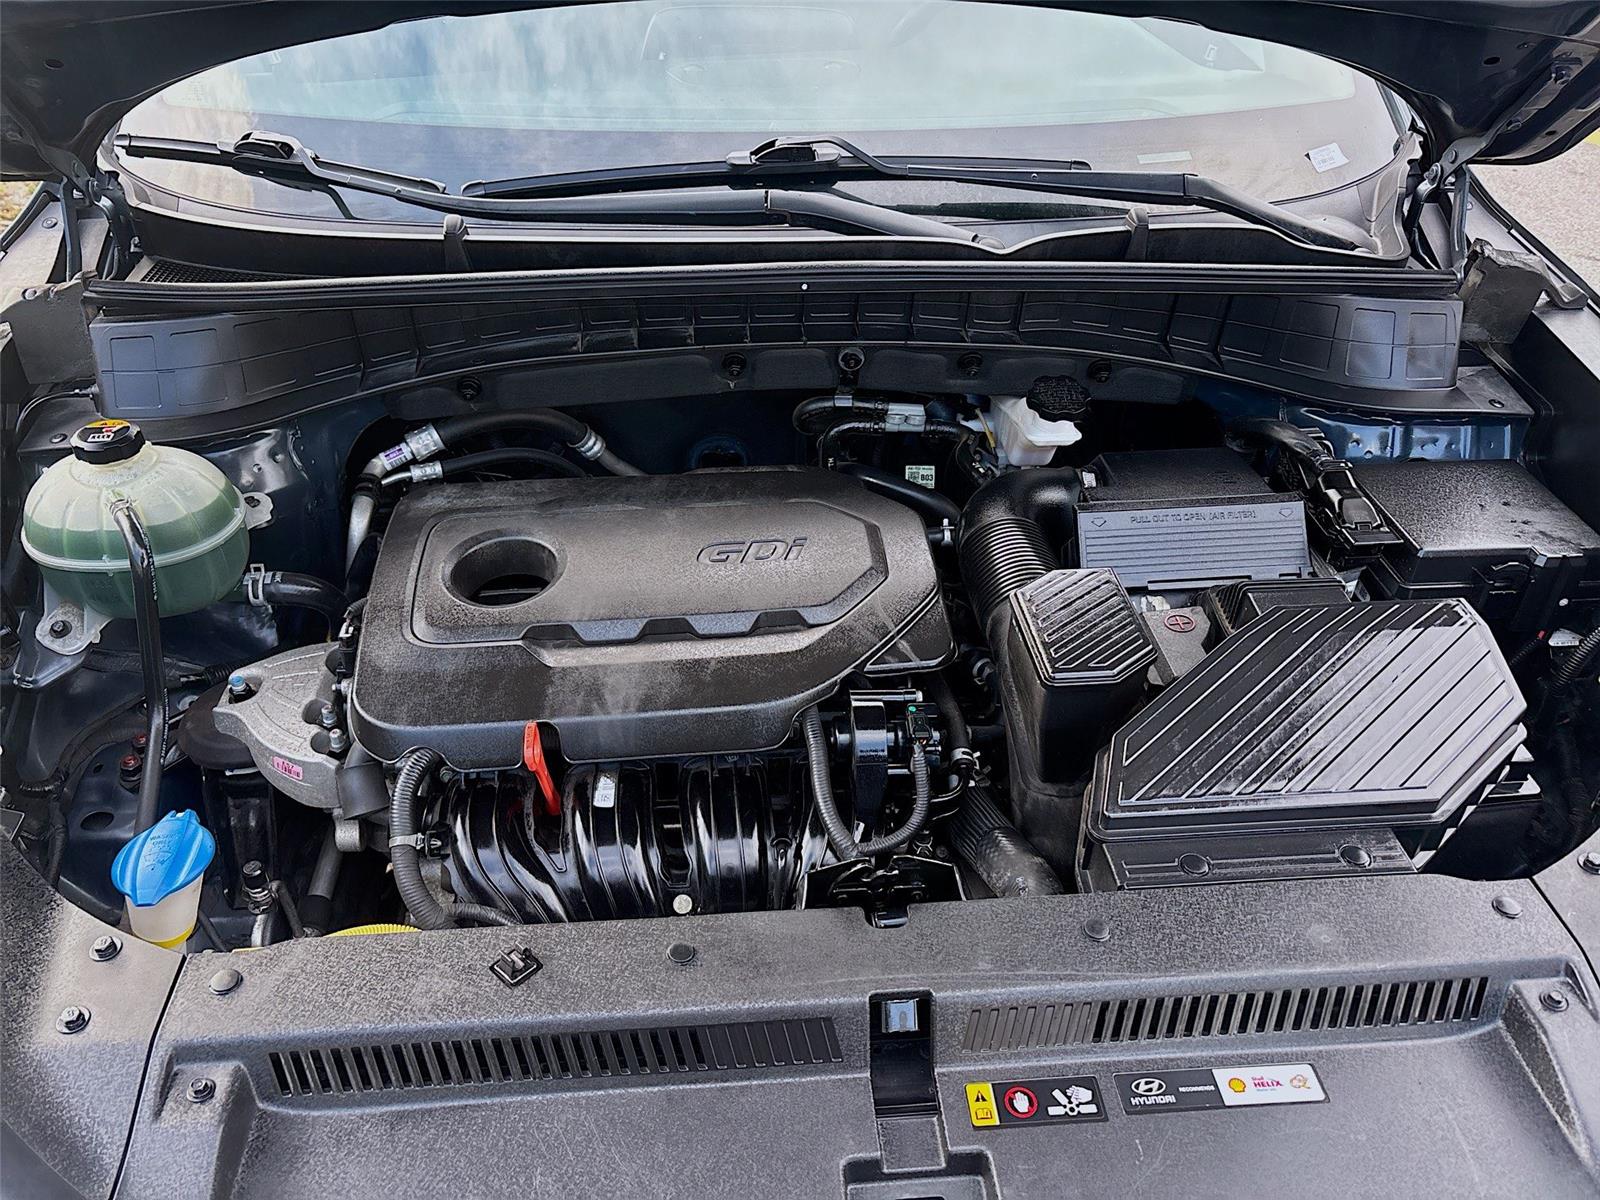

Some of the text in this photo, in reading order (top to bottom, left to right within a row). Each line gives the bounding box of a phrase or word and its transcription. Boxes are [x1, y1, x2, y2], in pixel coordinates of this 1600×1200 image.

[1130, 515, 1151, 524] PULL
[1152, 514, 1170, 523] OUT
[1171, 513, 1182, 522] TO
[1184, 512, 1206, 521] OPEN
[1253, 1080, 1284, 1088] HELIX
[1129, 1094, 1177, 1106] HYUNDAI
